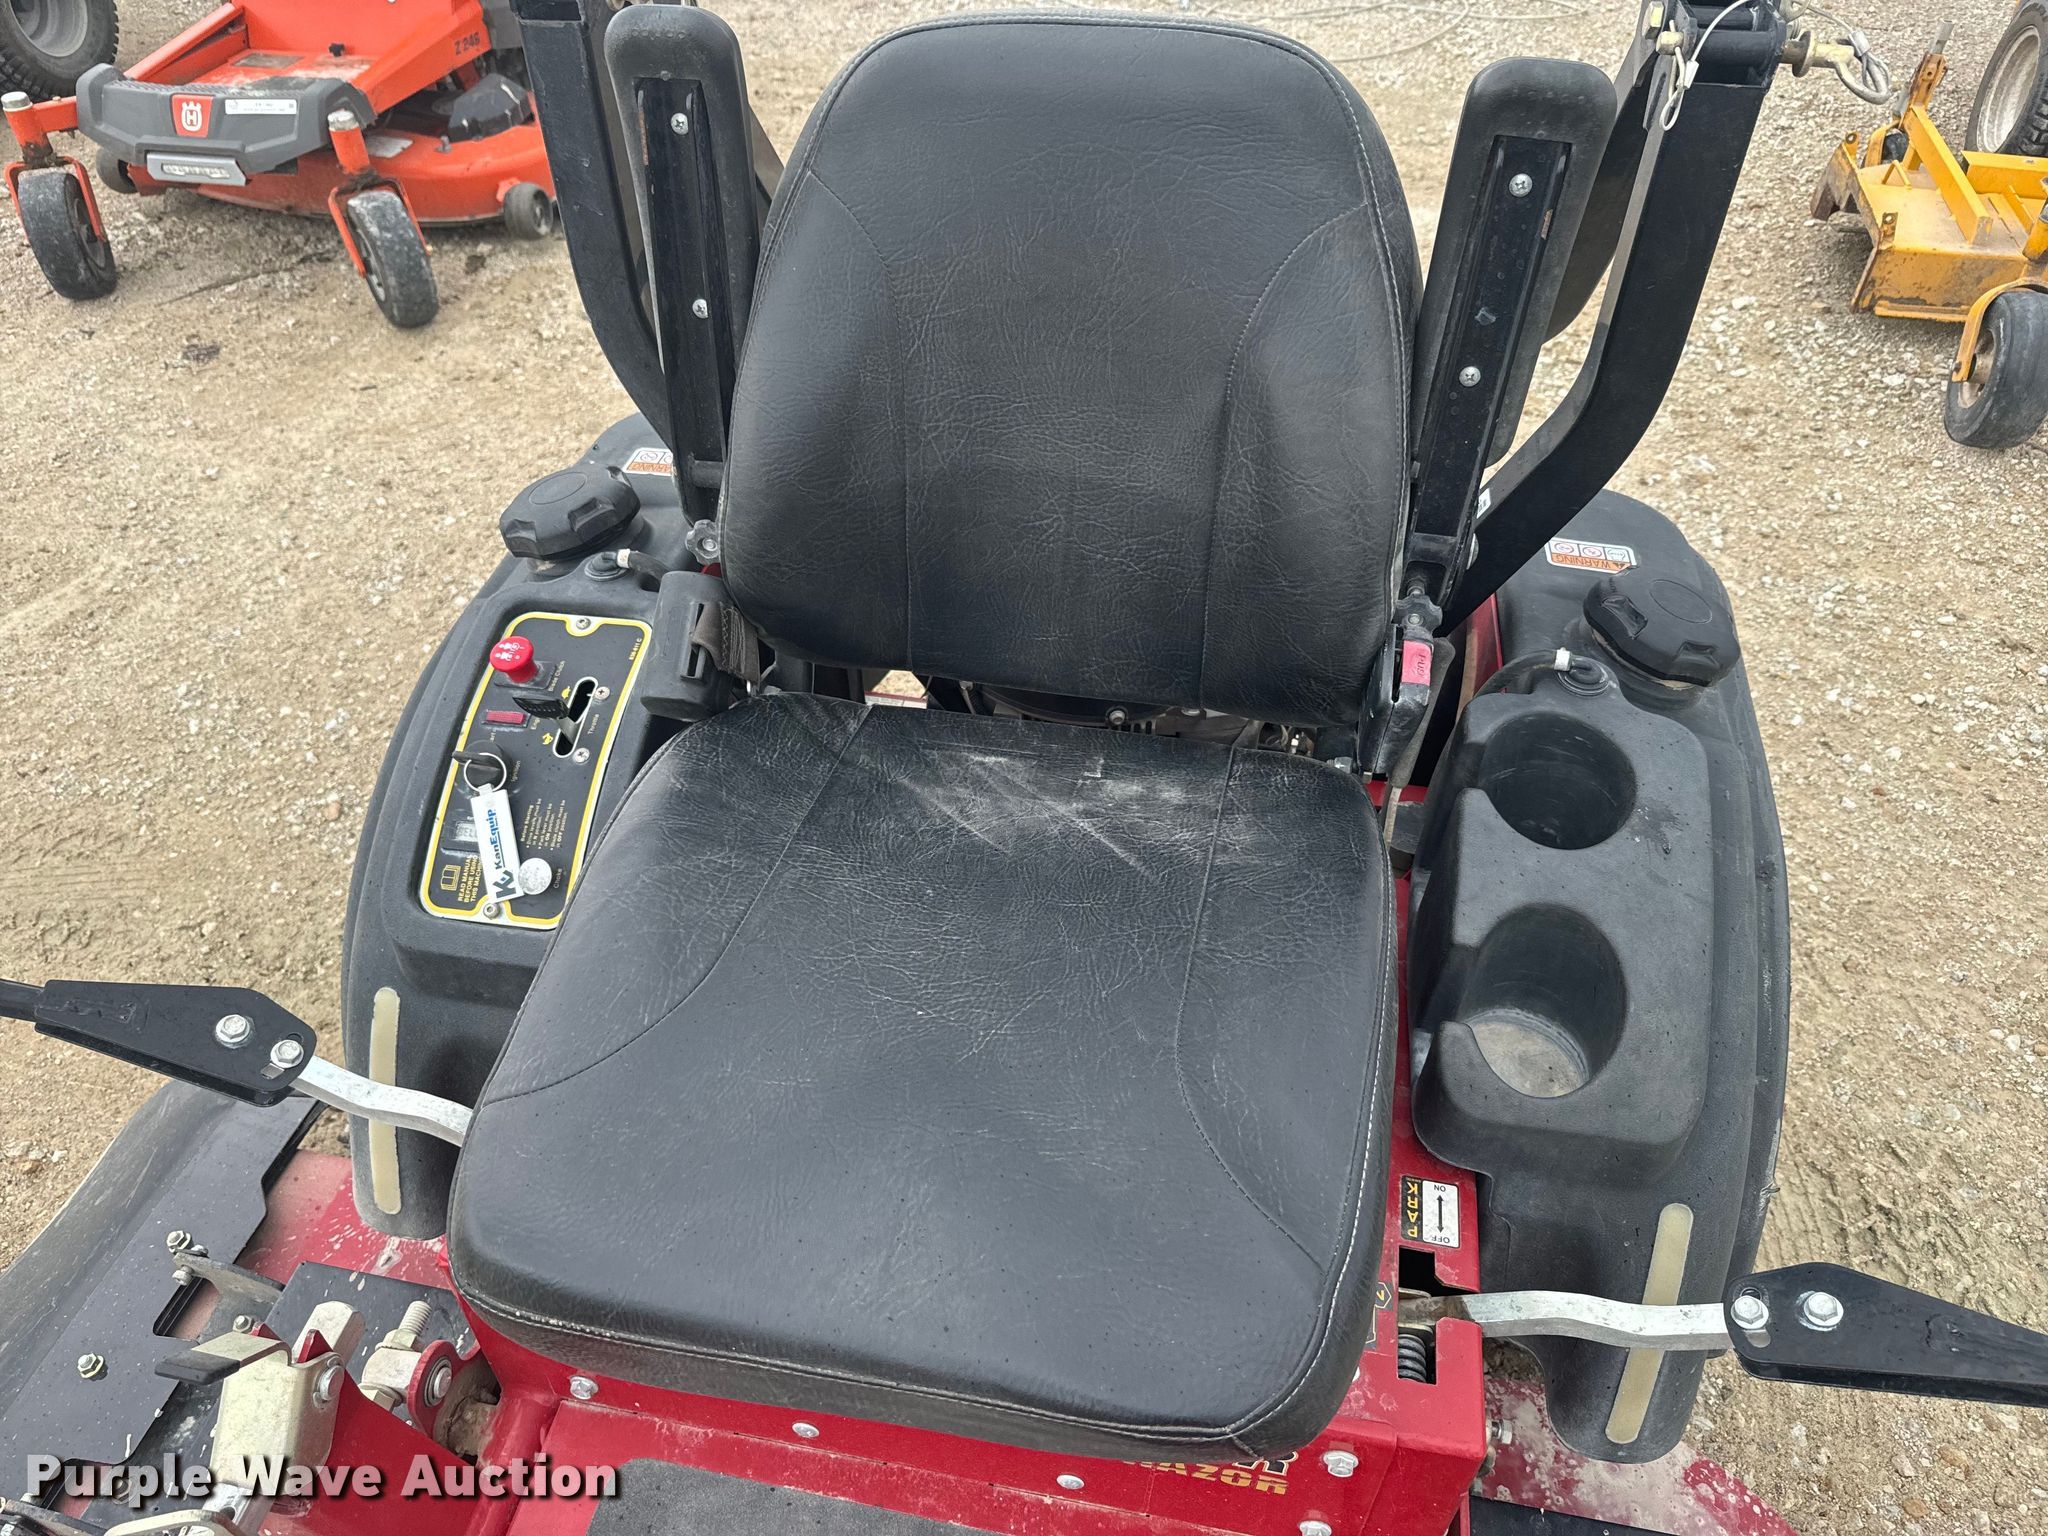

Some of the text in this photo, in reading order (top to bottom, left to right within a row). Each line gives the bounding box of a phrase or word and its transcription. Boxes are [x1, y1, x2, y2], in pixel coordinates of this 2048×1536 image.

[1556, 554, 1611, 569] WARNING
[548, 660, 566, 692] Blade Clutch
[587, 713, 600, 735] Throttle
[511, 761, 521, 782] Ignition
[487, 809, 503, 870] KanEquip
[457, 855, 473, 902] READ MANUAL
[464, 855, 479, 903] BEFORE USING
[553, 868, 563, 889] Choke
[470, 887, 479, 902] THIS
[1434, 1184, 1446, 1192] ON
[1407, 1182, 1418, 1237] PARK
[1432, 1235, 1450, 1243] OFF
[1123, 1461, 1289, 1495] AZOR
